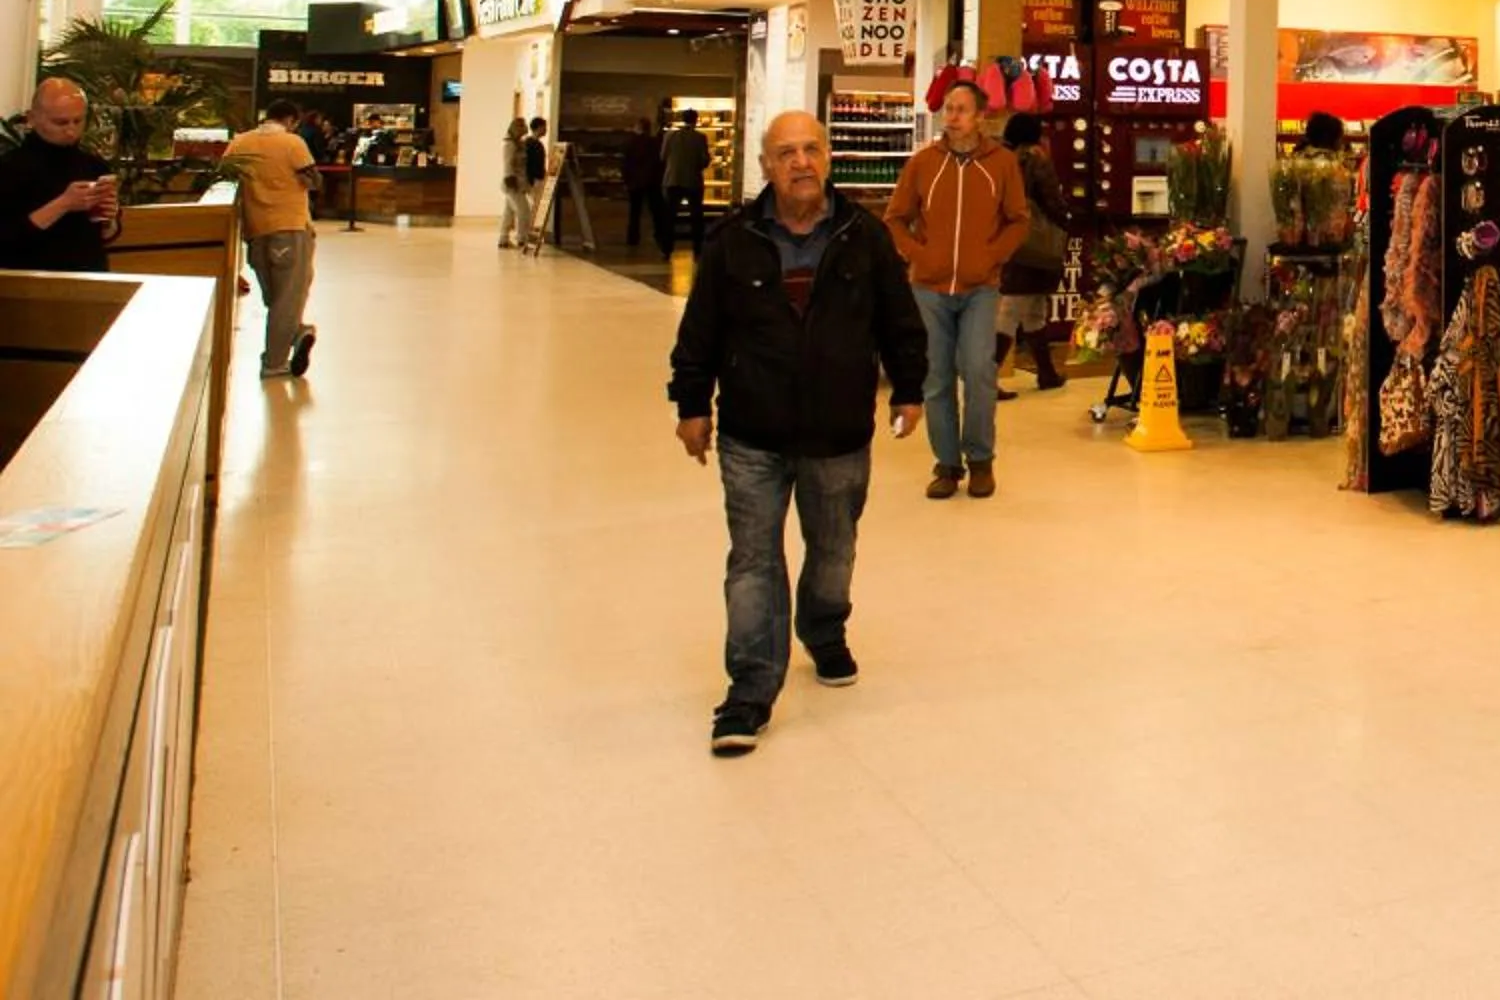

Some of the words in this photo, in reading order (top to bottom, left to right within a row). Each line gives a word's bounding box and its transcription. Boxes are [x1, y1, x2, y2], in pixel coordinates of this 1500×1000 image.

[862, 6, 907, 21] ZEN
[861, 24, 905, 40] NOO
[860, 43, 904, 57] DLE
[268, 69, 385, 87] BURGER
[1108, 57, 1201, 85] COSTA
[1138, 86, 1201, 104] EXPRESS
